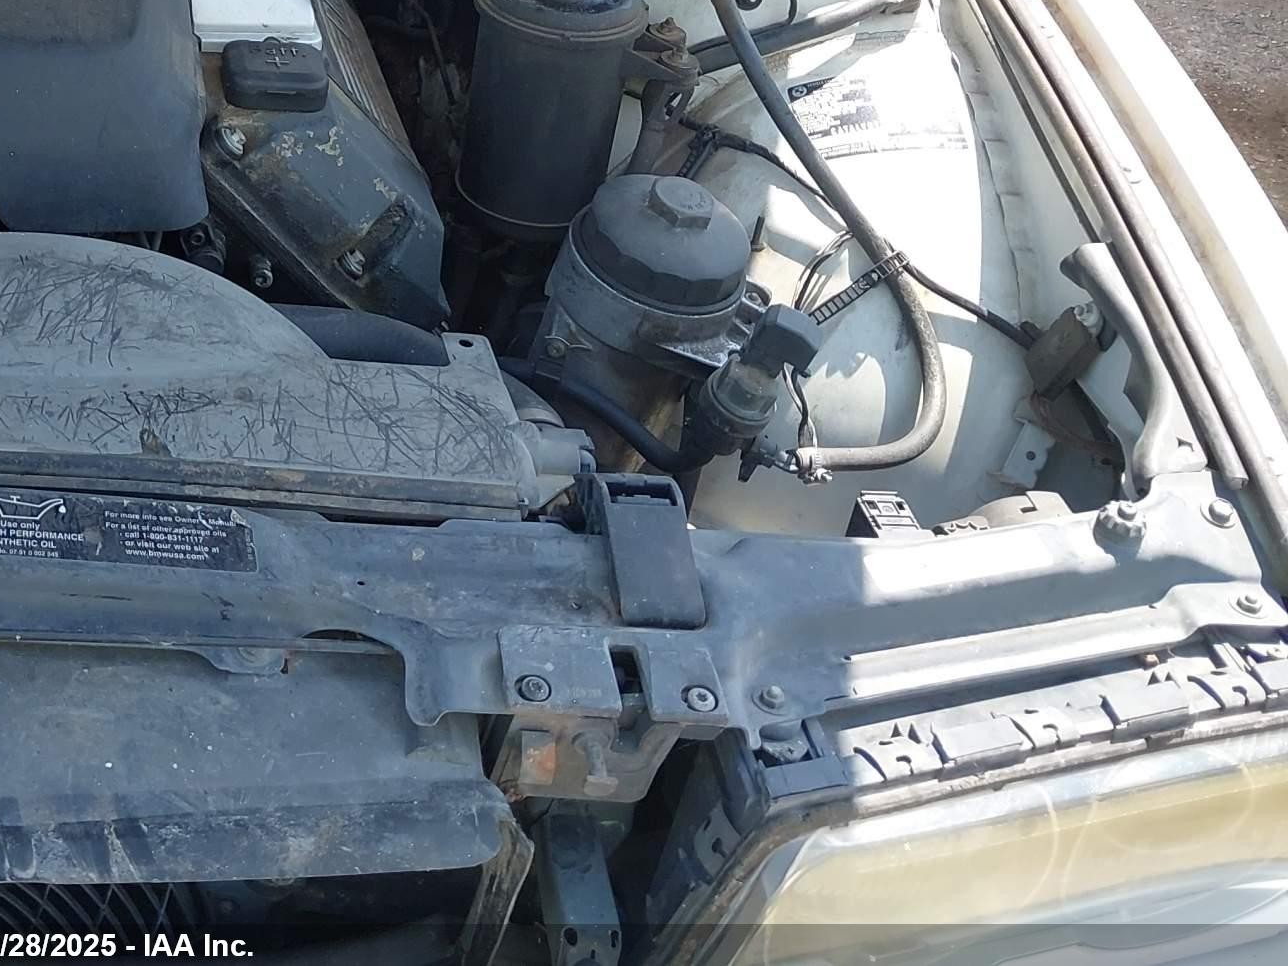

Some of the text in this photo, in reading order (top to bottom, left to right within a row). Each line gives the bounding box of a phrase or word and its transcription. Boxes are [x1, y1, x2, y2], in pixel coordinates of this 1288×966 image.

[0, 520, 40, 531] Use only
[106, 521, 119, 529] For
[9, 529, 84, 541] PERFORMANCE
[41, 540, 57, 549] OIL
[125, 549, 206, 561] www.bmwusa.com
